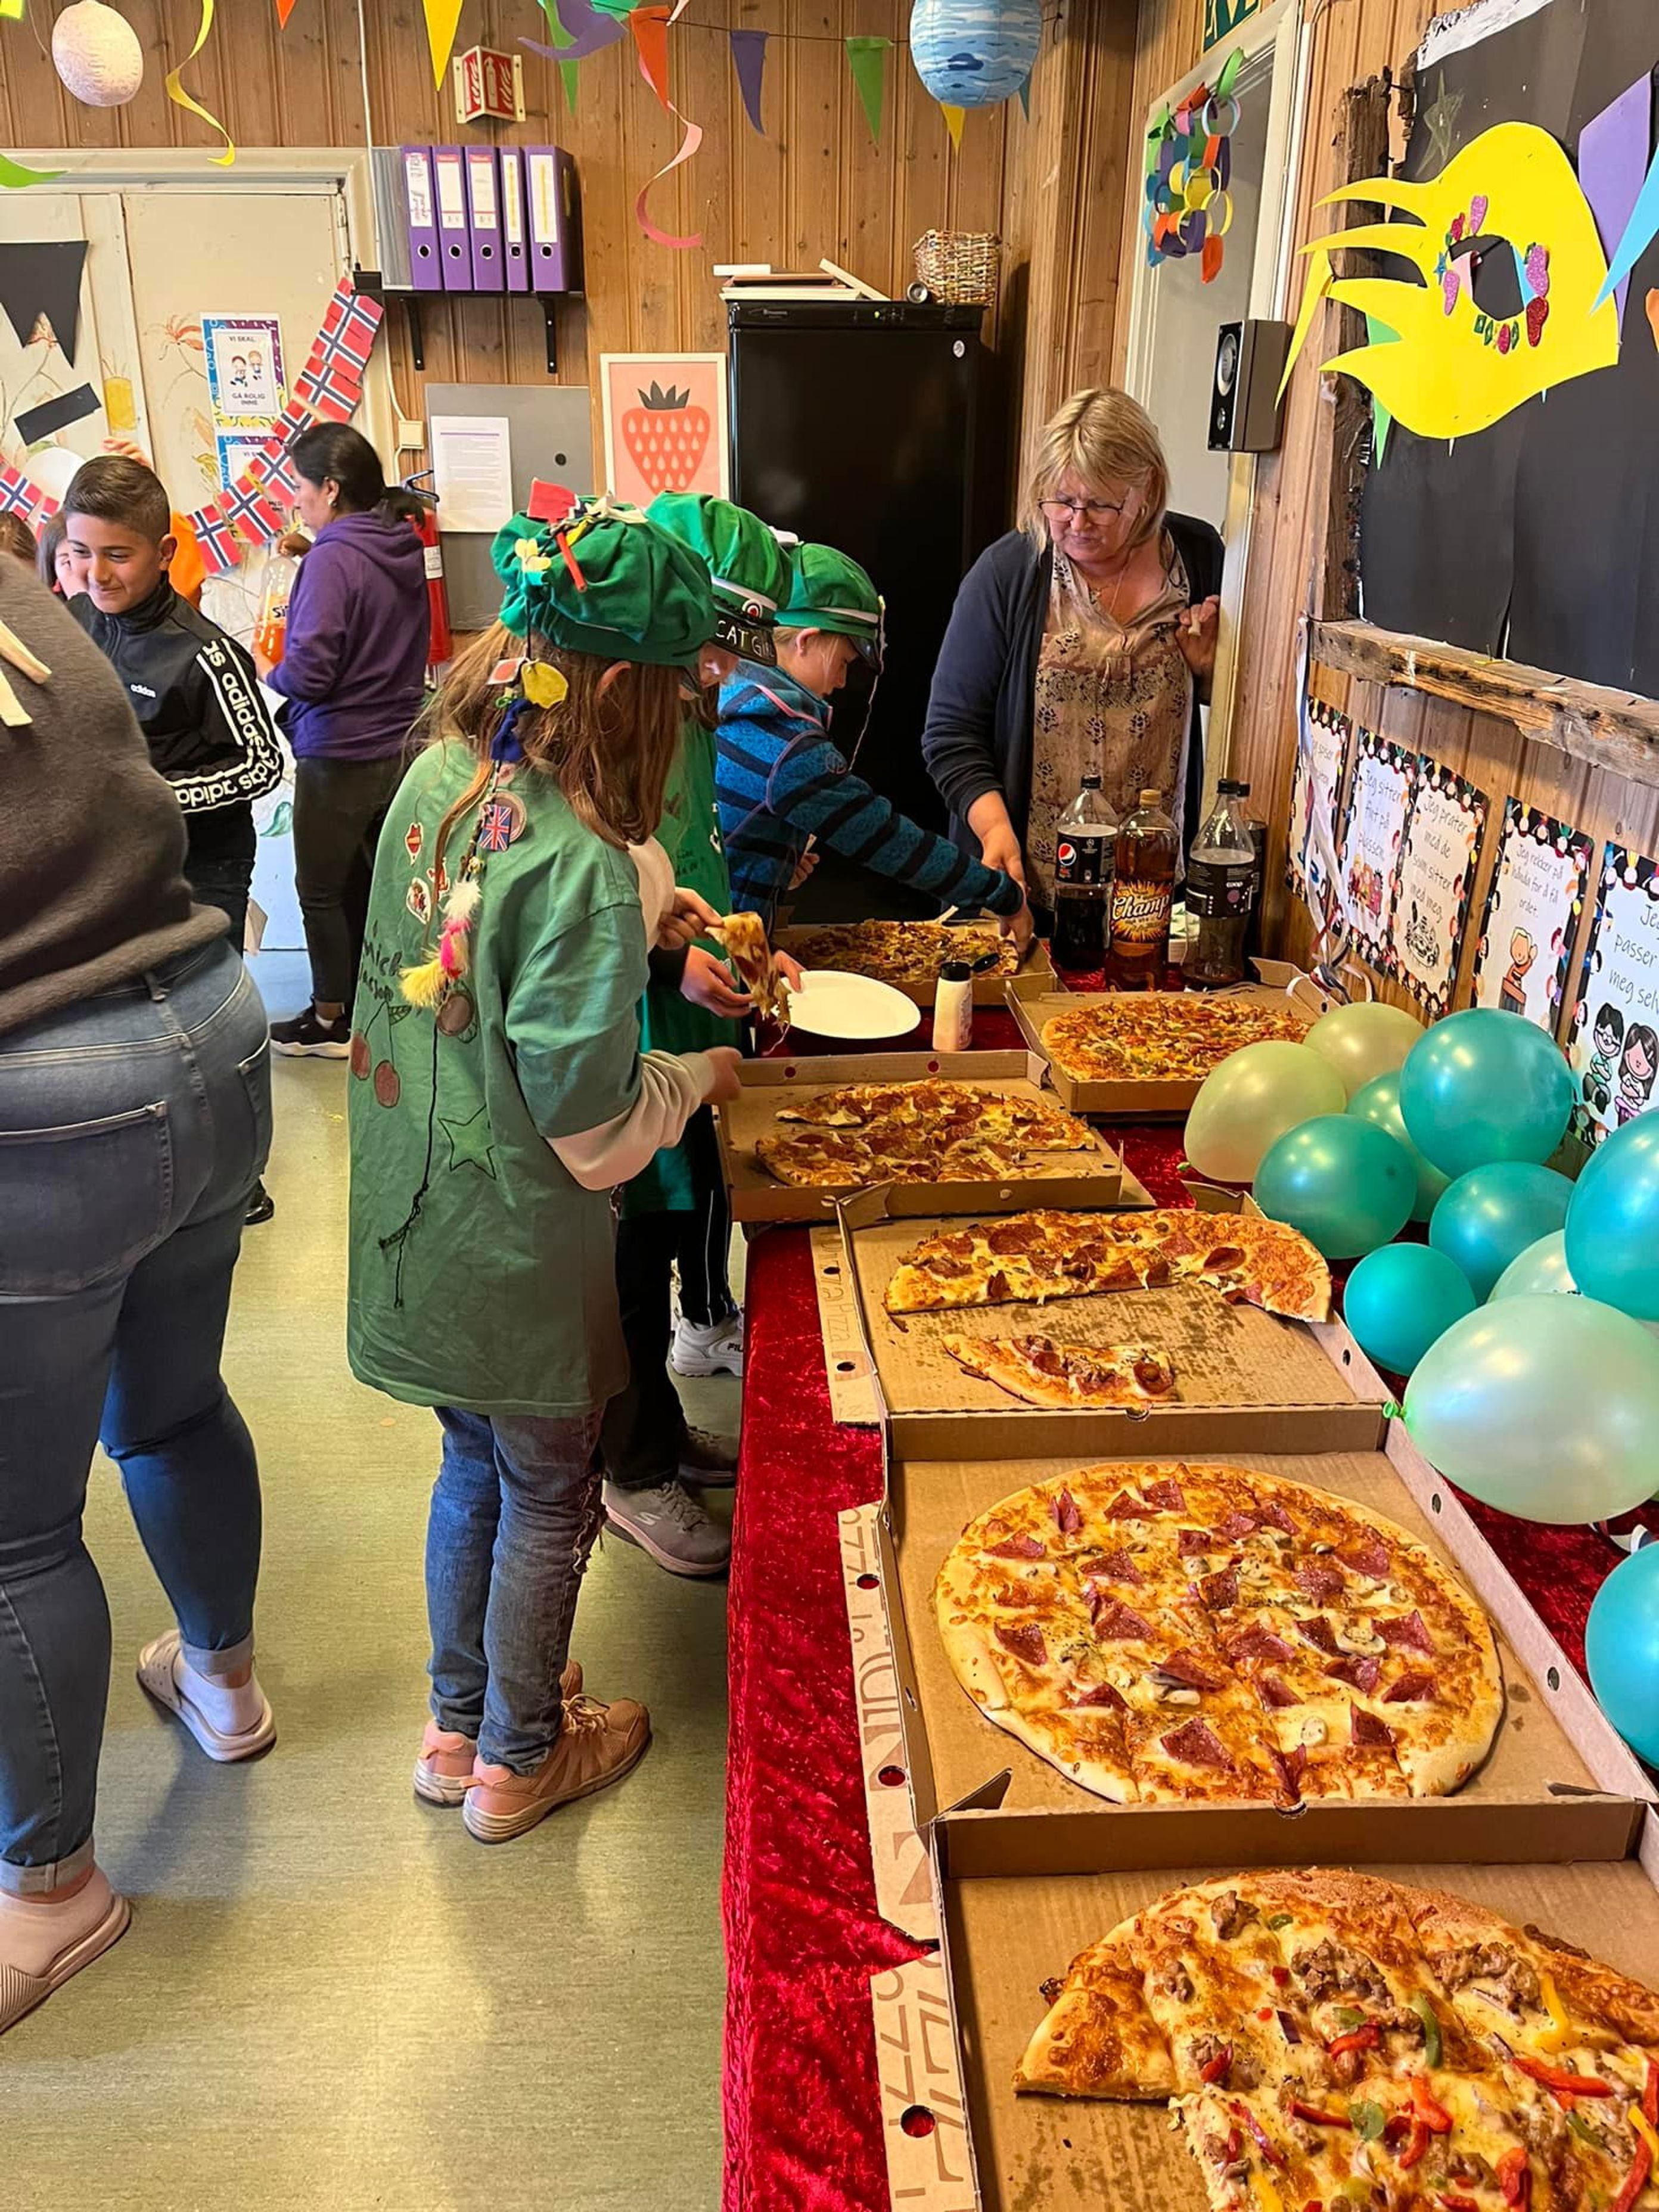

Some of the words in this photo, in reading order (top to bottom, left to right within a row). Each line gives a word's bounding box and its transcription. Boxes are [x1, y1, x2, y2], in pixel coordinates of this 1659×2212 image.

[716, 620, 749, 648] CAT
[175, 779, 238, 807] adida
[1363, 769, 1378, 797] Jeg
[1378, 781, 1402, 804] sitter
[1379, 812, 1390, 829] på
[1424, 794, 1440, 822] Jeg
[1439, 807, 1468, 835] prater
[1424, 829, 1441, 853] med
[1441, 838, 1452, 859] de
[1517, 843, 1529, 866] Jeg
[1412, 854, 1427, 874] som
[1428, 864, 1452, 892] sitter
[1531, 877, 1542, 893] for
[1410, 883, 1426, 905] med
[1614, 934, 1658, 968] passer
[1609, 968, 1634, 1005] meg
[727, 1343, 744, 1352] FIL
